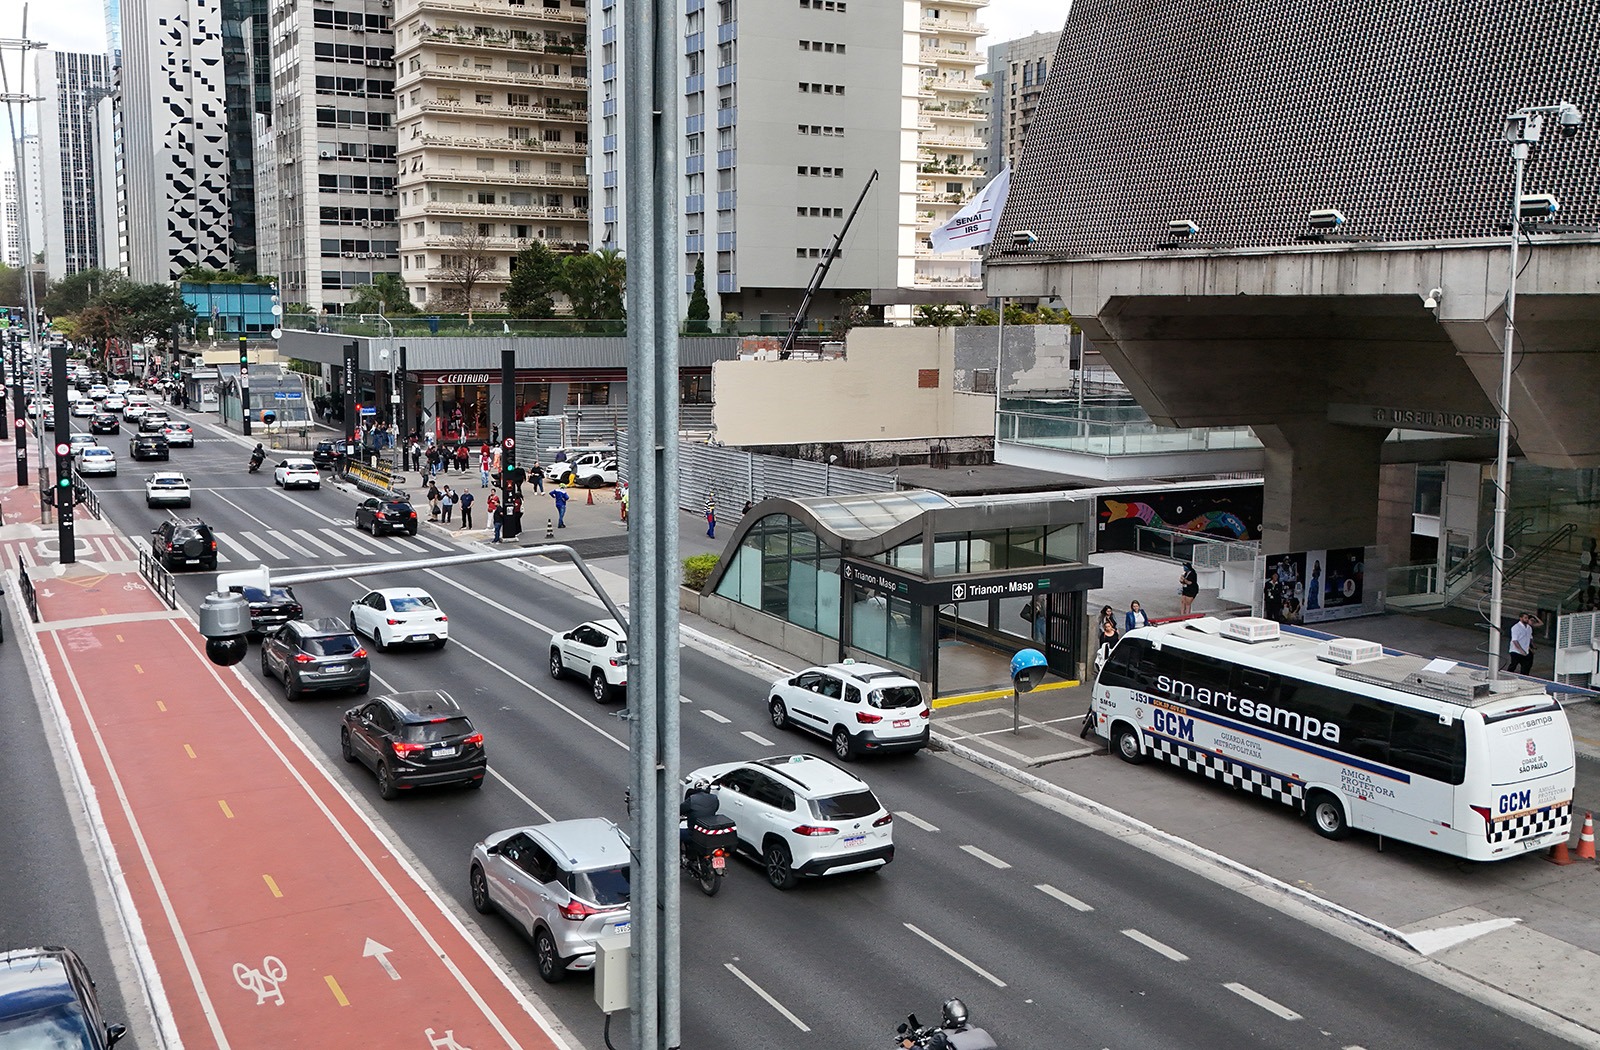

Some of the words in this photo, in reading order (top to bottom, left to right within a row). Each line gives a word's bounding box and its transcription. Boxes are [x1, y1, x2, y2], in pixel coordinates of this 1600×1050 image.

[956, 214, 982, 226] SENAI
[965, 225, 979, 233] IRS
[448, 374, 489, 383] CENTAURO
[1135, 692, 1148, 705] 153
[1156, 675, 1341, 743] smartsampa
[1153, 708, 1195, 743] GCM
[1501, 715, 1553, 734] smartsampa
[1531, 761, 1548, 772] PAULO
[1341, 768, 1372, 783] AMIGA
[1341, 775, 1396, 799] PROTETORA
[1341, 783, 1375, 800] ALIADA
[1499, 789, 1531, 814] GCM
